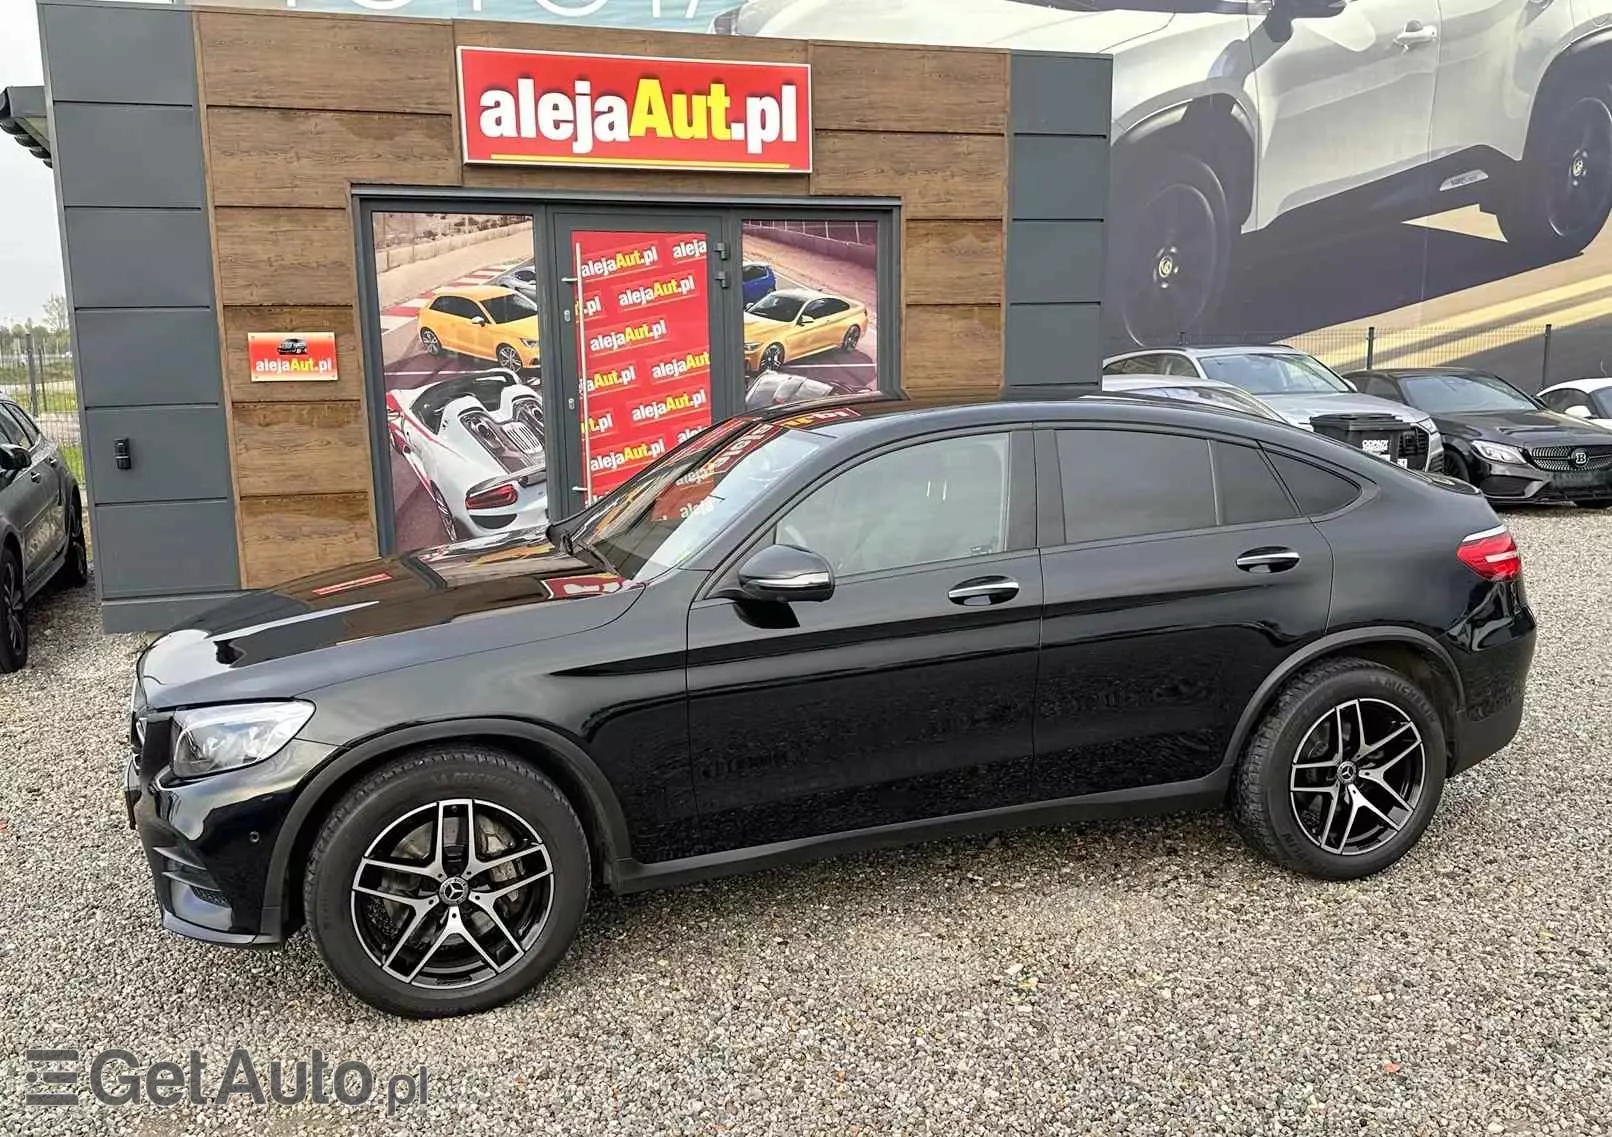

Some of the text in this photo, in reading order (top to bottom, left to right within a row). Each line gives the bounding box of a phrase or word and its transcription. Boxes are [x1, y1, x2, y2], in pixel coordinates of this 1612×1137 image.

[479, 78, 797, 153] alejaAut.pl
[581, 246, 658, 277] alejaAut.pl
[618, 275, 695, 306] alejaAut.pl
[590, 320, 666, 351] alejaAut.pl
[255, 358, 332, 373] alejaAut.pl
[632, 389, 706, 421] alejaAut.pl
[590, 439, 665, 471] alejaAut.pl
